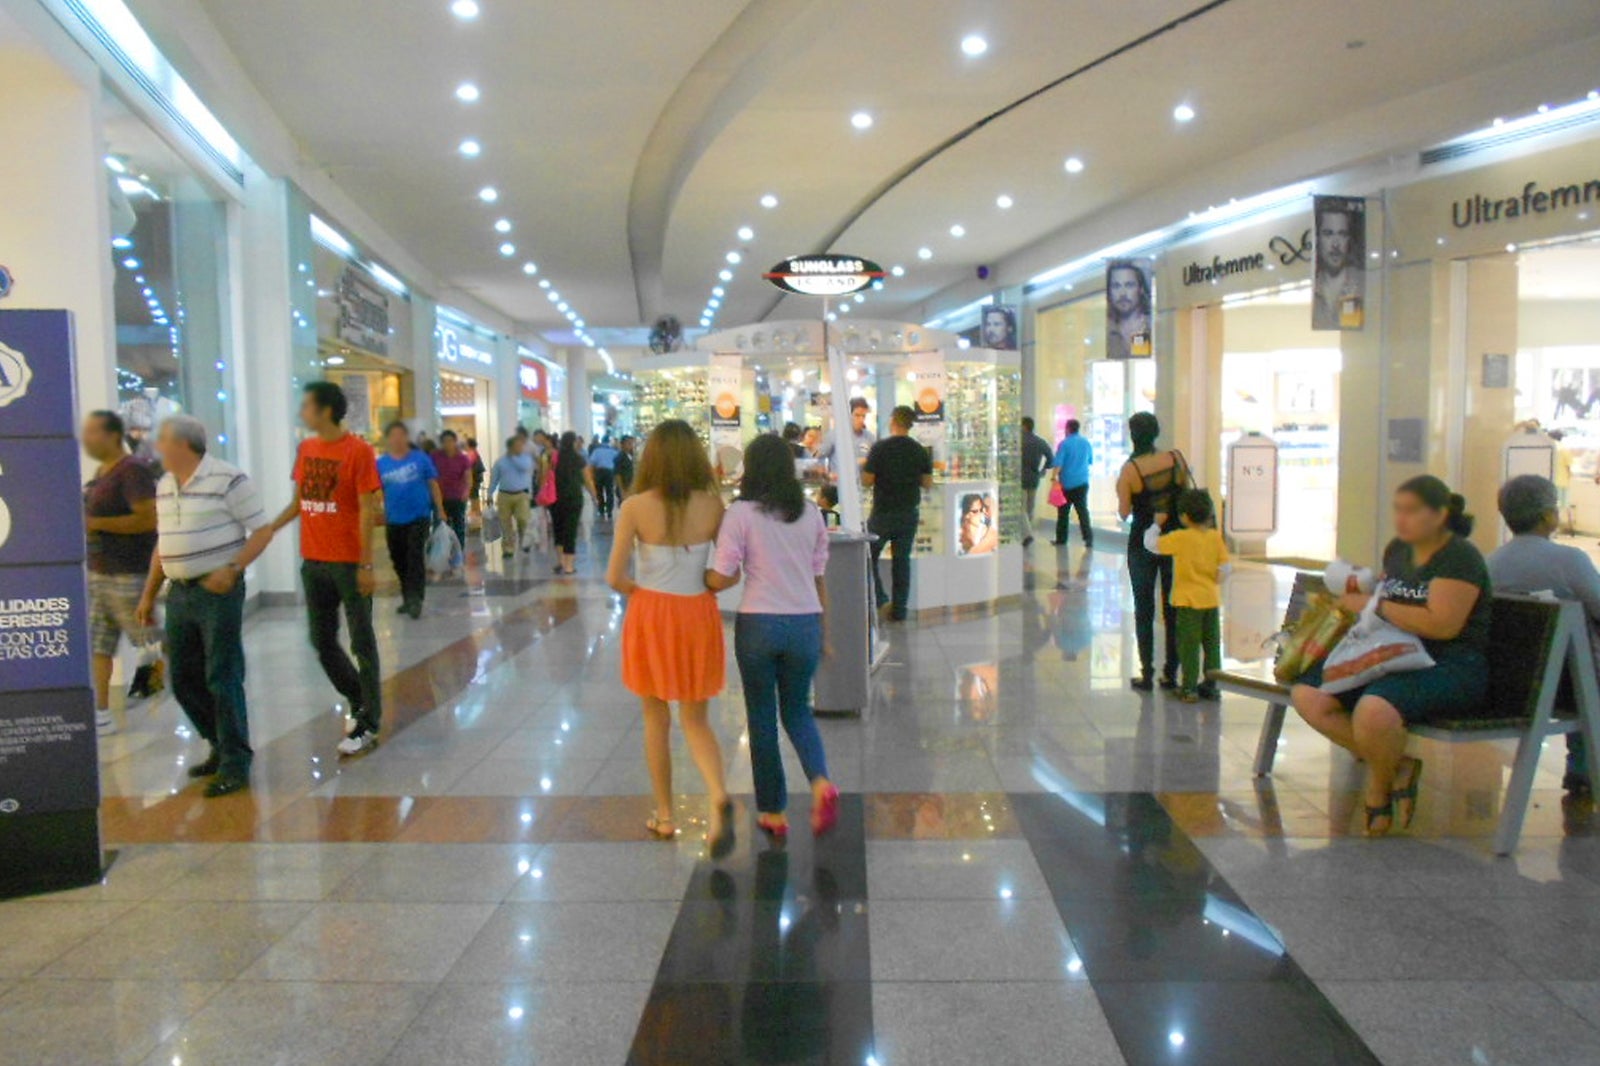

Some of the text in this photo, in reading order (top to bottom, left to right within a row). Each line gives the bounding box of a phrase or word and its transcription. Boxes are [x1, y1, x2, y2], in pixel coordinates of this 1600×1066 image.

[789, 259, 864, 273] SUNGLASS
[1183, 252, 1264, 287] Ultrafemme
[797, 277, 856, 286] ISAND
[35, 629, 69, 644] TUS
[34, 643, 69, 658] C&A
